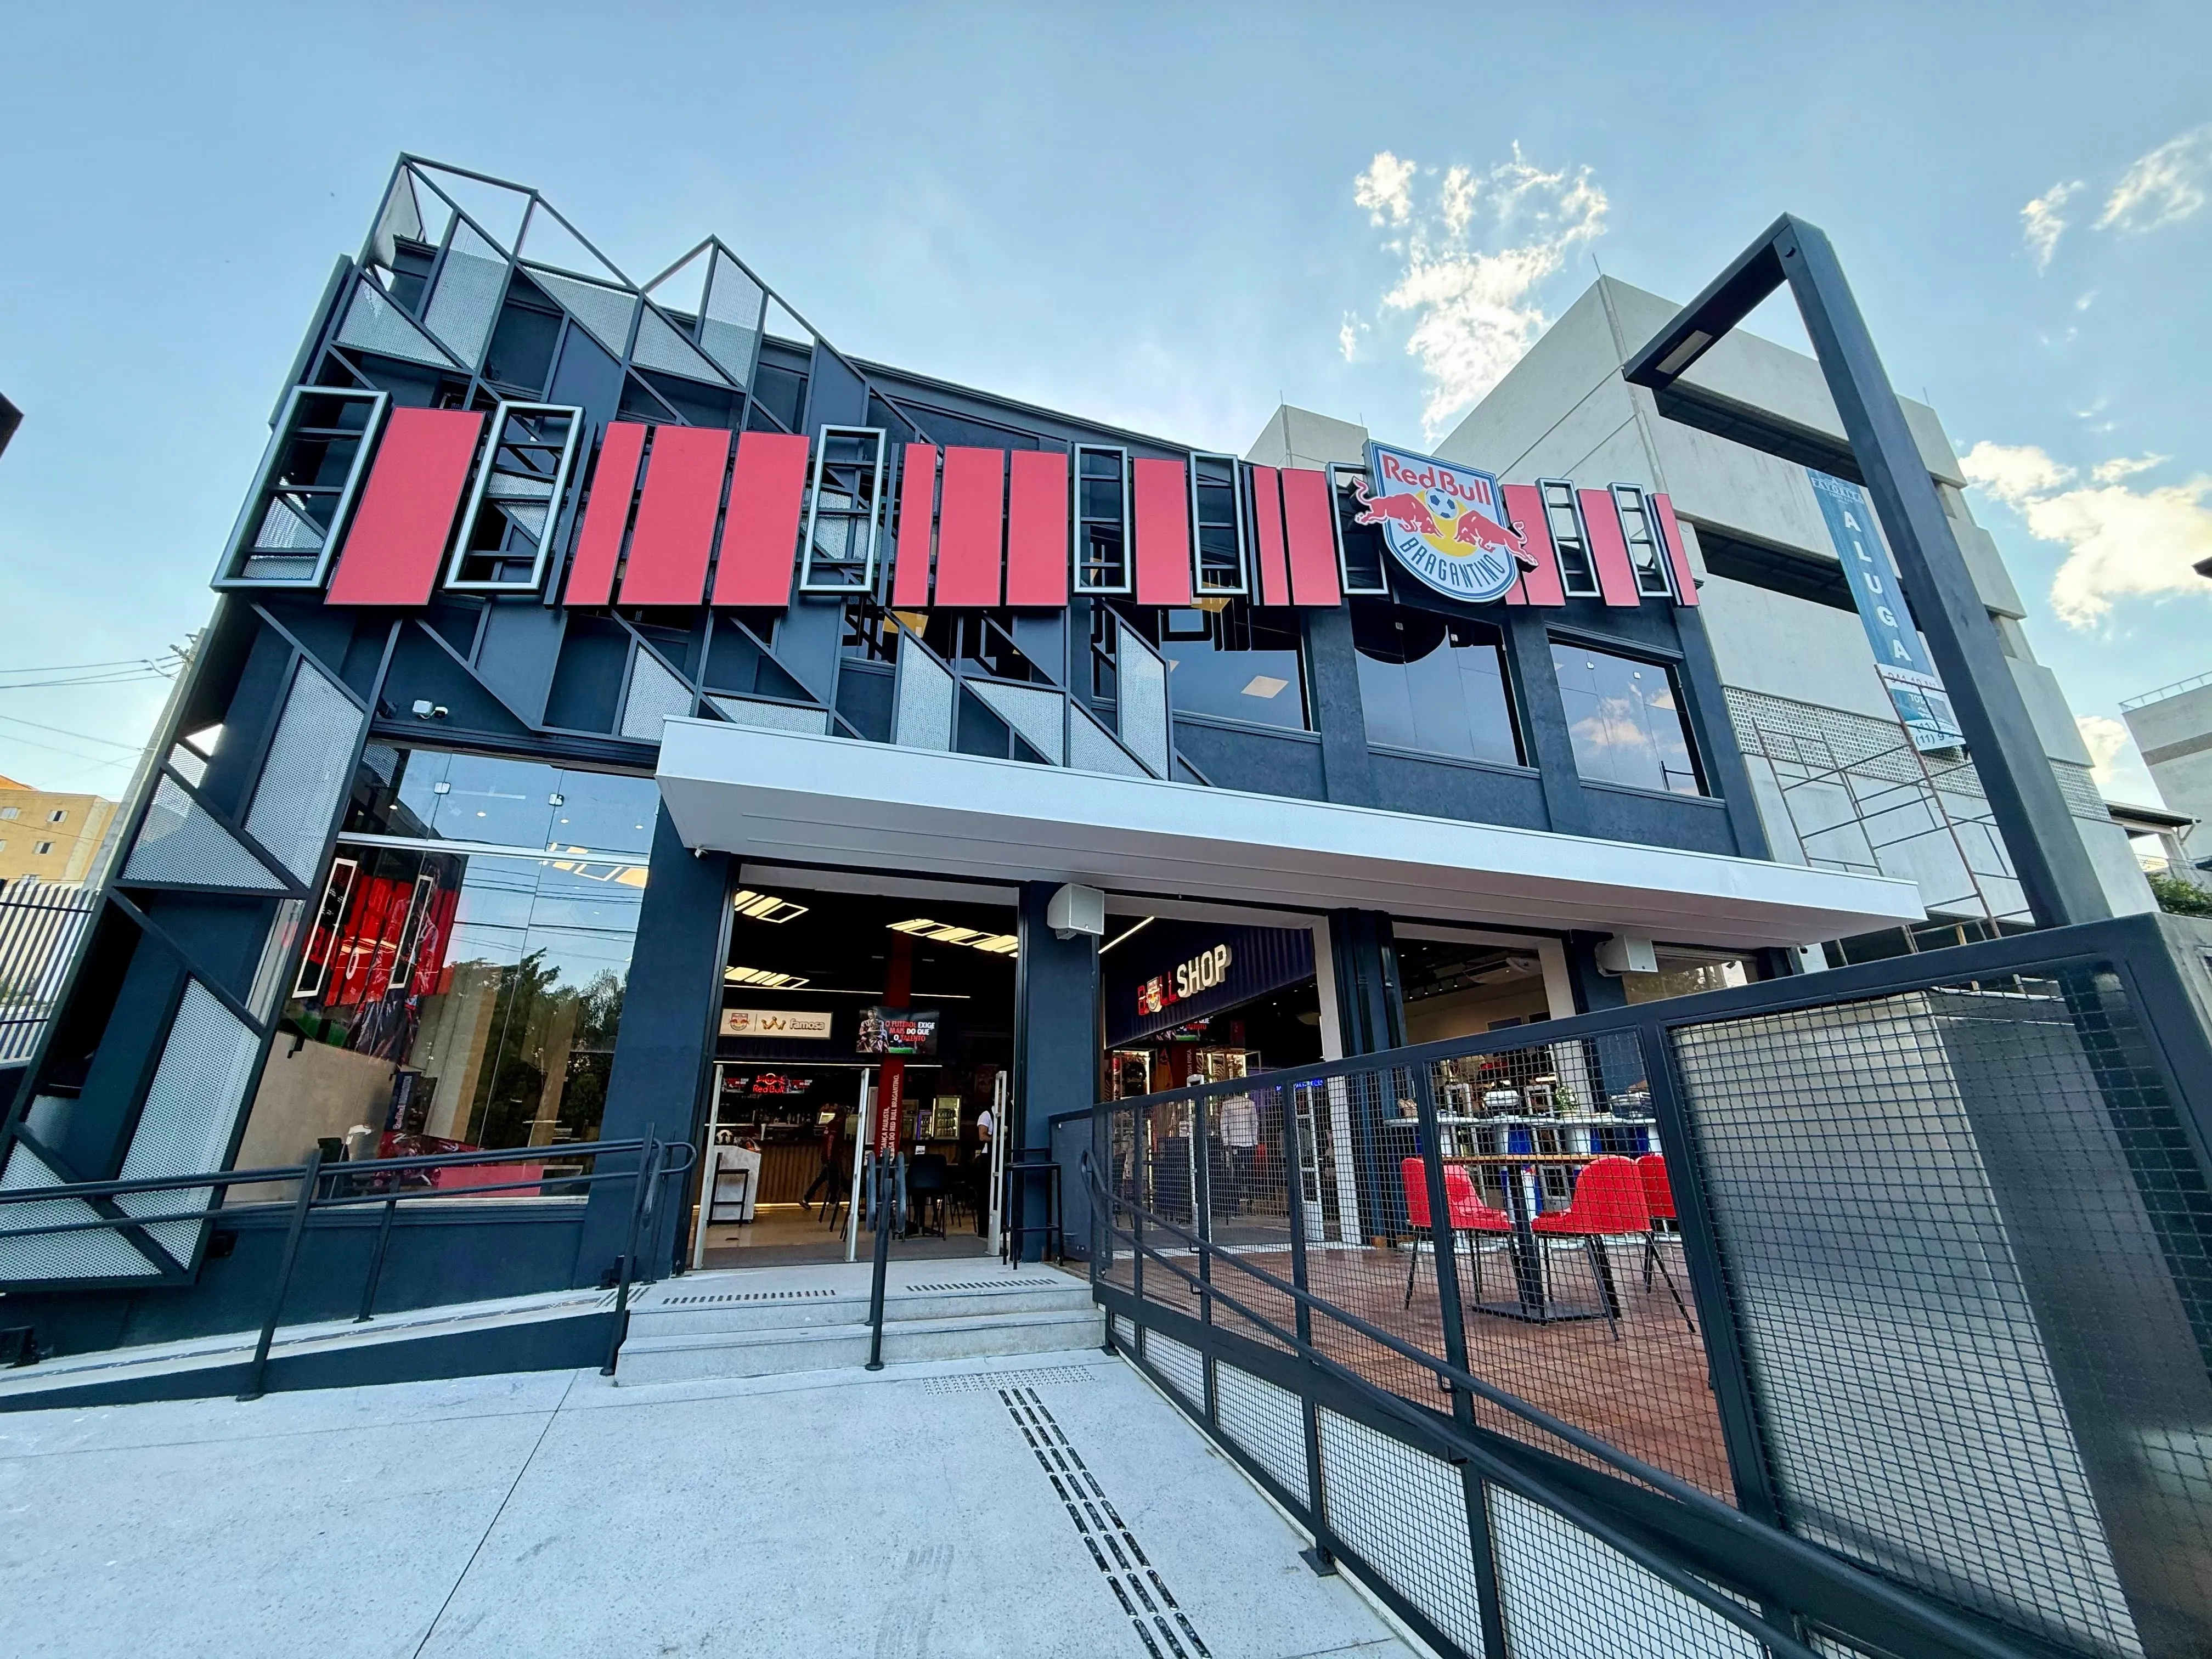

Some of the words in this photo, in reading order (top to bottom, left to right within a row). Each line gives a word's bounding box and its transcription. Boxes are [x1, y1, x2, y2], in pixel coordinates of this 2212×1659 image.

[1382, 454, 1436, 489] Red
[1438, 469, 1492, 506] Bull
[1399, 537, 1505, 589] BRAGANTINO
[1843, 510, 1912, 663] ALUGA
[1915, 733, 1935, 746] (11)
[1137, 971, 1179, 1015] BLL
[1176, 944, 1230, 998] SHOP
[789, 1018, 826, 1031] famosa
[891, 1020, 917, 1029] FUTEBOL
[917, 1021, 935, 1029] EXIGE
[753, 1084, 769, 1093] Red
[889, 1132, 895, 1141] DO
